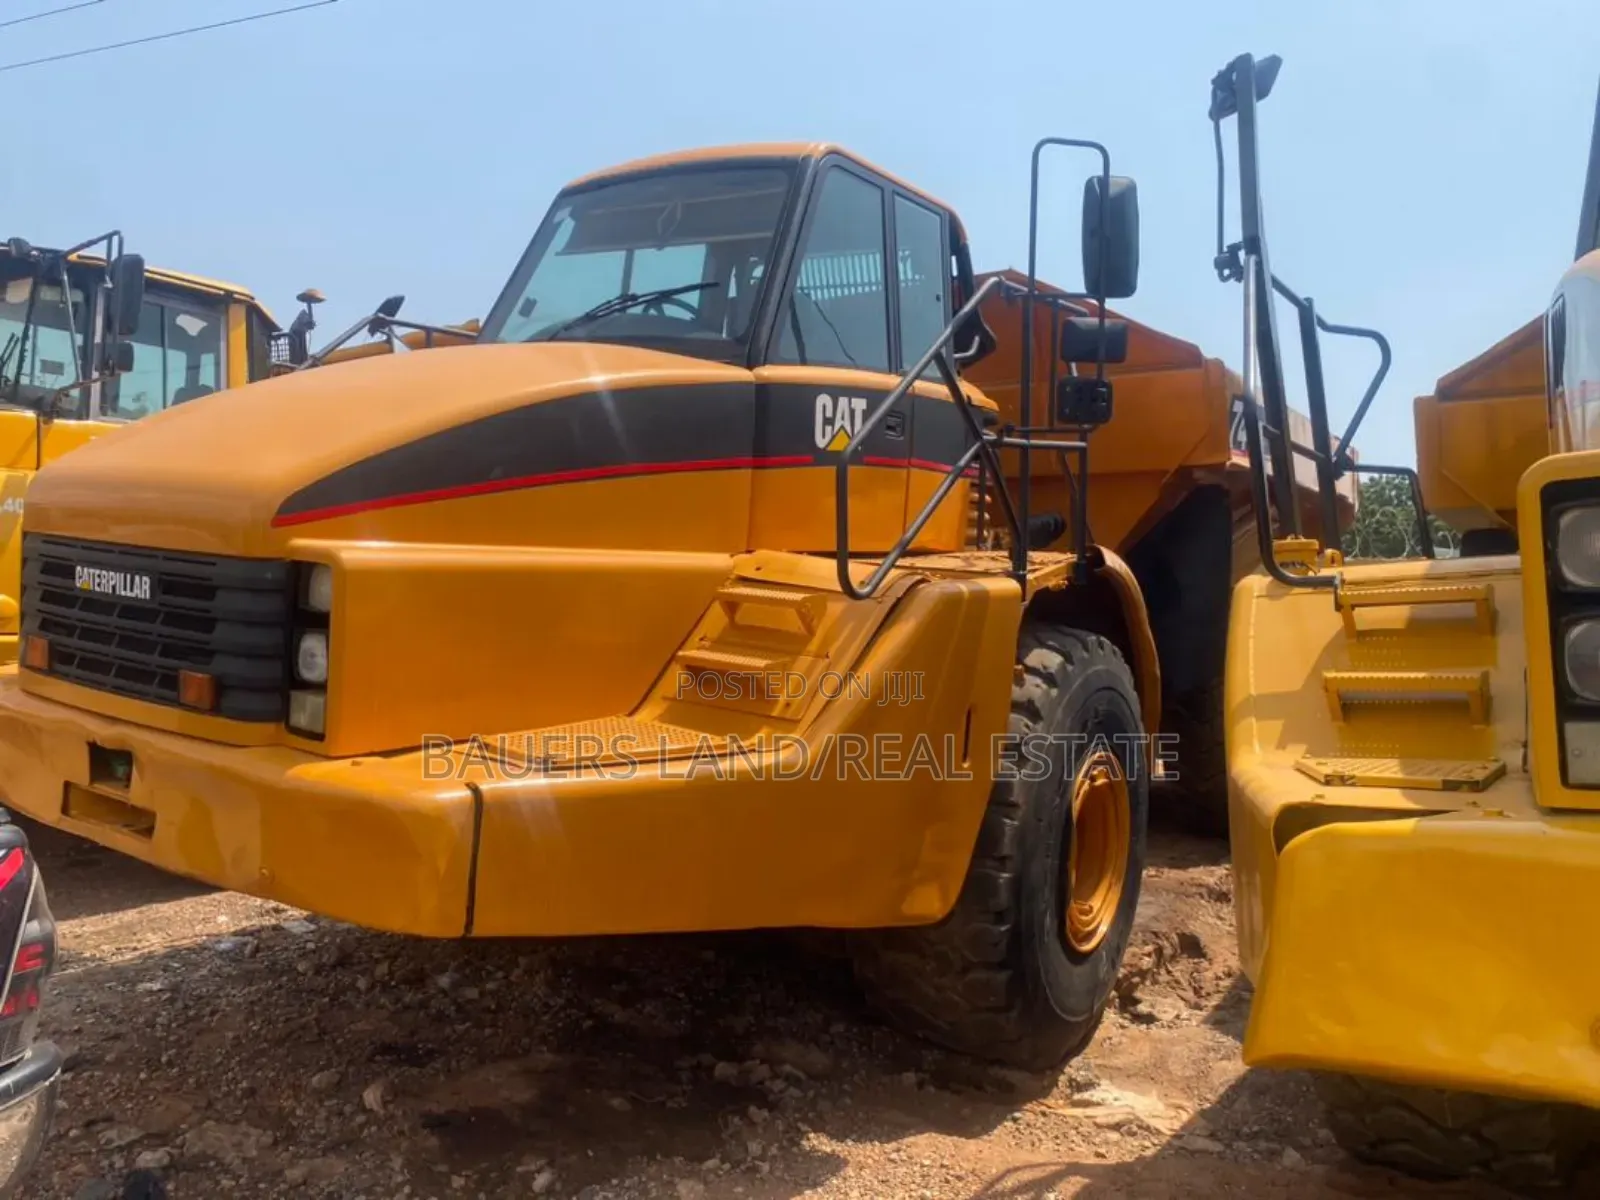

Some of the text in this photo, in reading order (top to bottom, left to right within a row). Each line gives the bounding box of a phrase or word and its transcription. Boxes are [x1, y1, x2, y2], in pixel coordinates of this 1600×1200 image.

[814, 392, 868, 451] CAT
[0, 497, 24, 513] 40
[75, 565, 151, 600] CATERPILLAR
